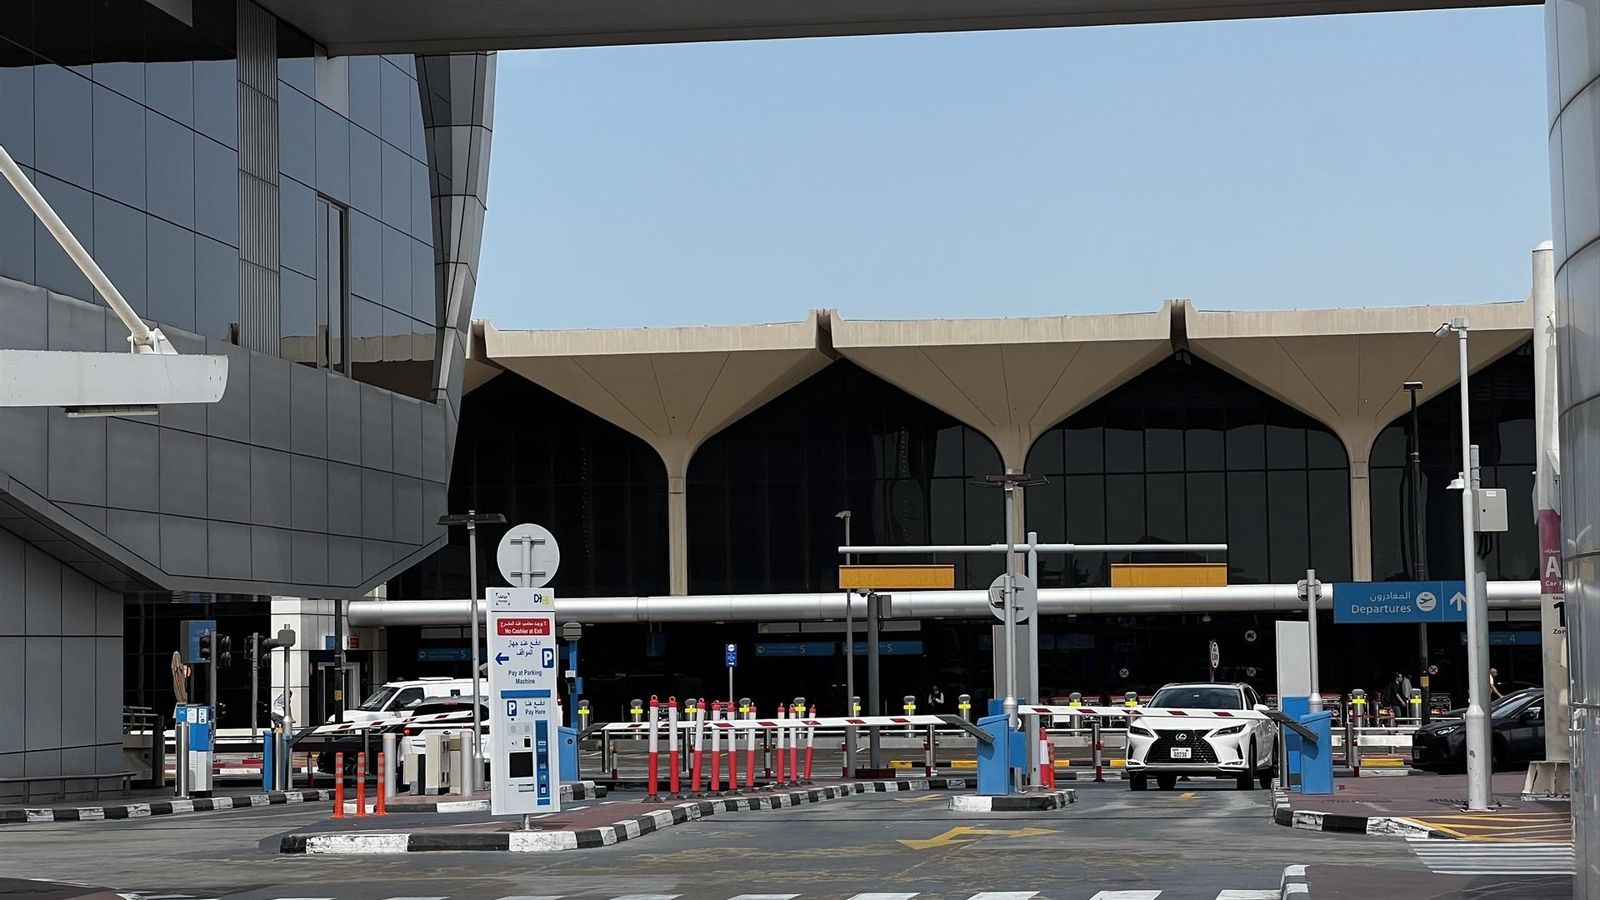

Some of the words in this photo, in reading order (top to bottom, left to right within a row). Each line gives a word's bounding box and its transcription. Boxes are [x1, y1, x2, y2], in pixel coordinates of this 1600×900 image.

[1545, 556, 1562, 578] A
[1351, 603, 1412, 615] Departures
[1553, 601, 1566, 627] 1
[543, 650, 553, 666] P
[508, 669, 518, 677] Pay
[523, 669, 543, 677] Parking
[508, 701, 516, 715] P
